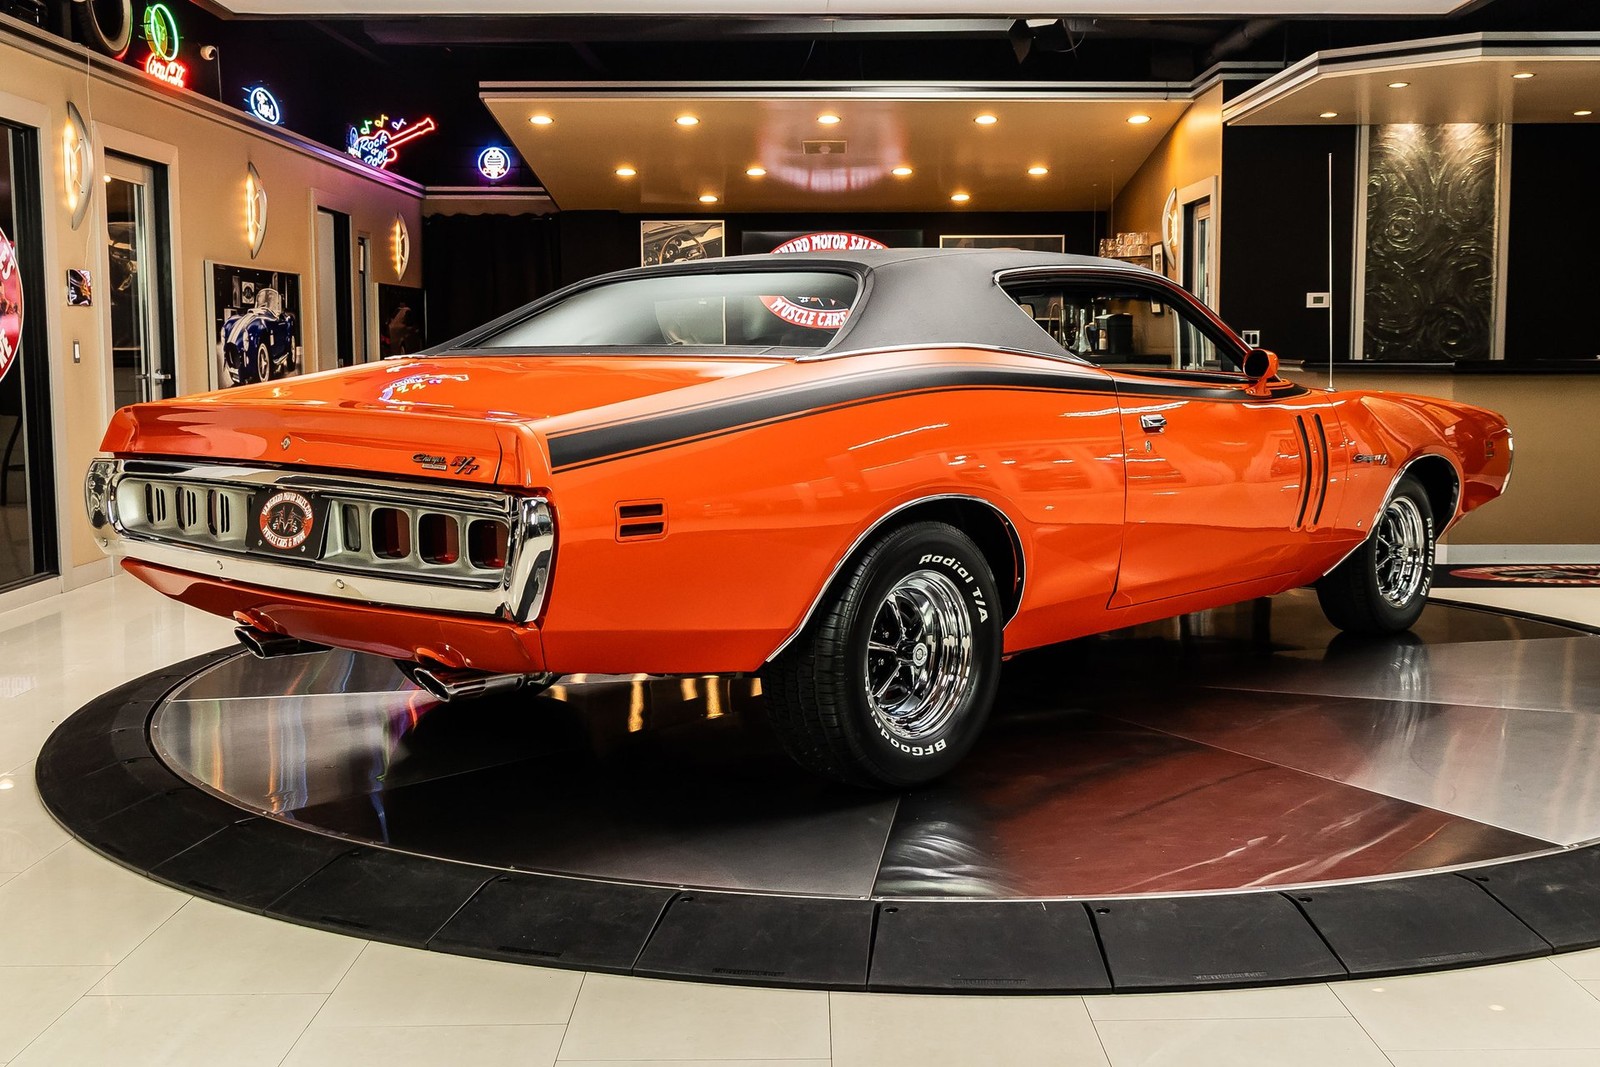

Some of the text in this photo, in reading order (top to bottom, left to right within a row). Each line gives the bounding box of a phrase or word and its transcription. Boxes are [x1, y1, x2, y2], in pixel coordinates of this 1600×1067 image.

[359, 131, 388, 152] Rock
[810, 234, 848, 250] MOTOR
[769, 297, 847, 326] MUSCLE CARS
[450, 455, 479, 474] R/T
[1419, 517, 1434, 597] Radial T/A
[918, 553, 989, 623] Radial T/A
